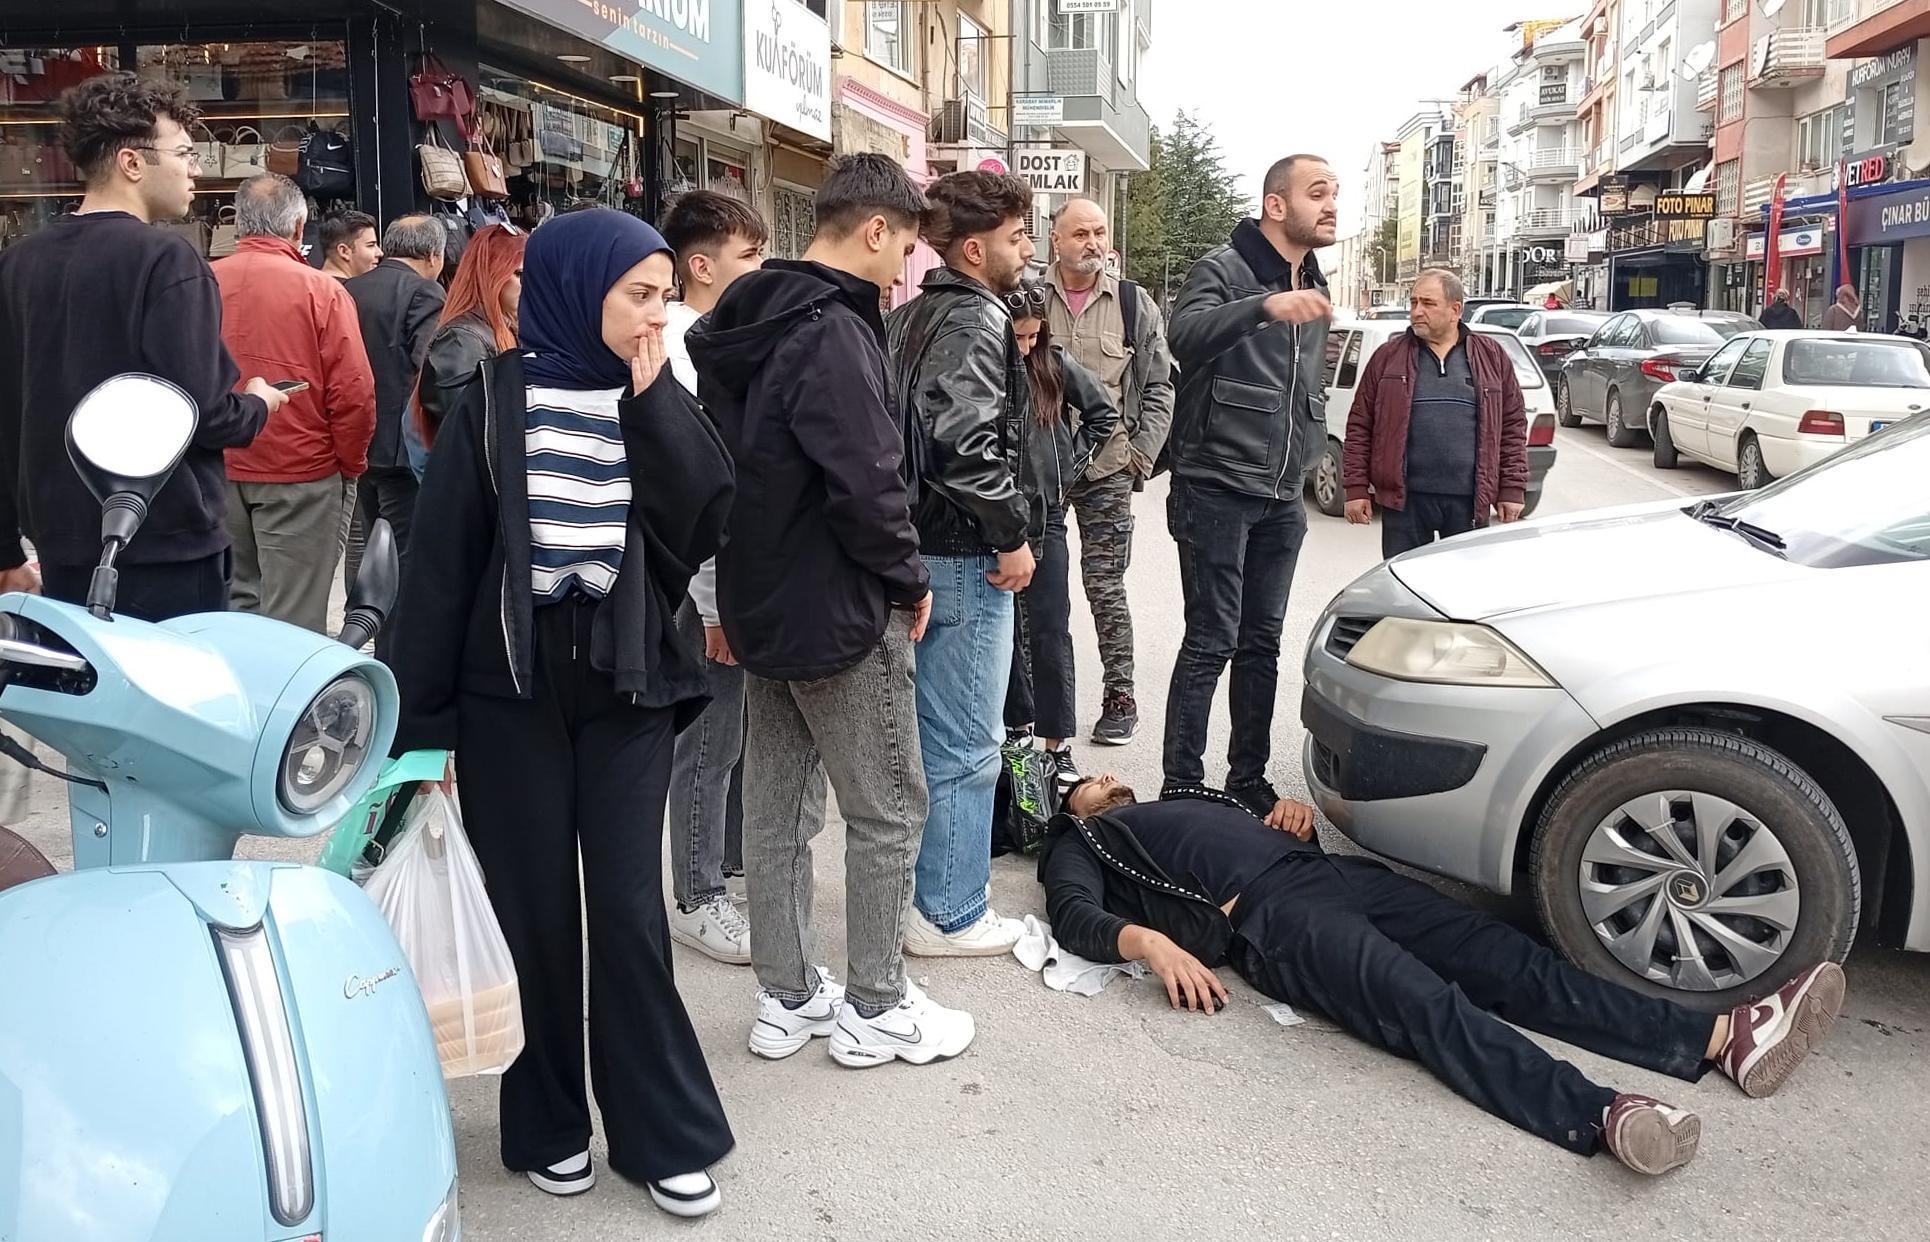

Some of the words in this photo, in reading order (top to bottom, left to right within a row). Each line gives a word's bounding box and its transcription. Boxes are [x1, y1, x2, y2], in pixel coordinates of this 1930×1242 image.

[593, 1, 630, 31] senin
[1020, 156, 1061, 171] DOST
[1657, 197, 1683, 214] FOTO
[1685, 196, 1714, 213] PINAR
[1881, 203, 1913, 232] ÇINAR
